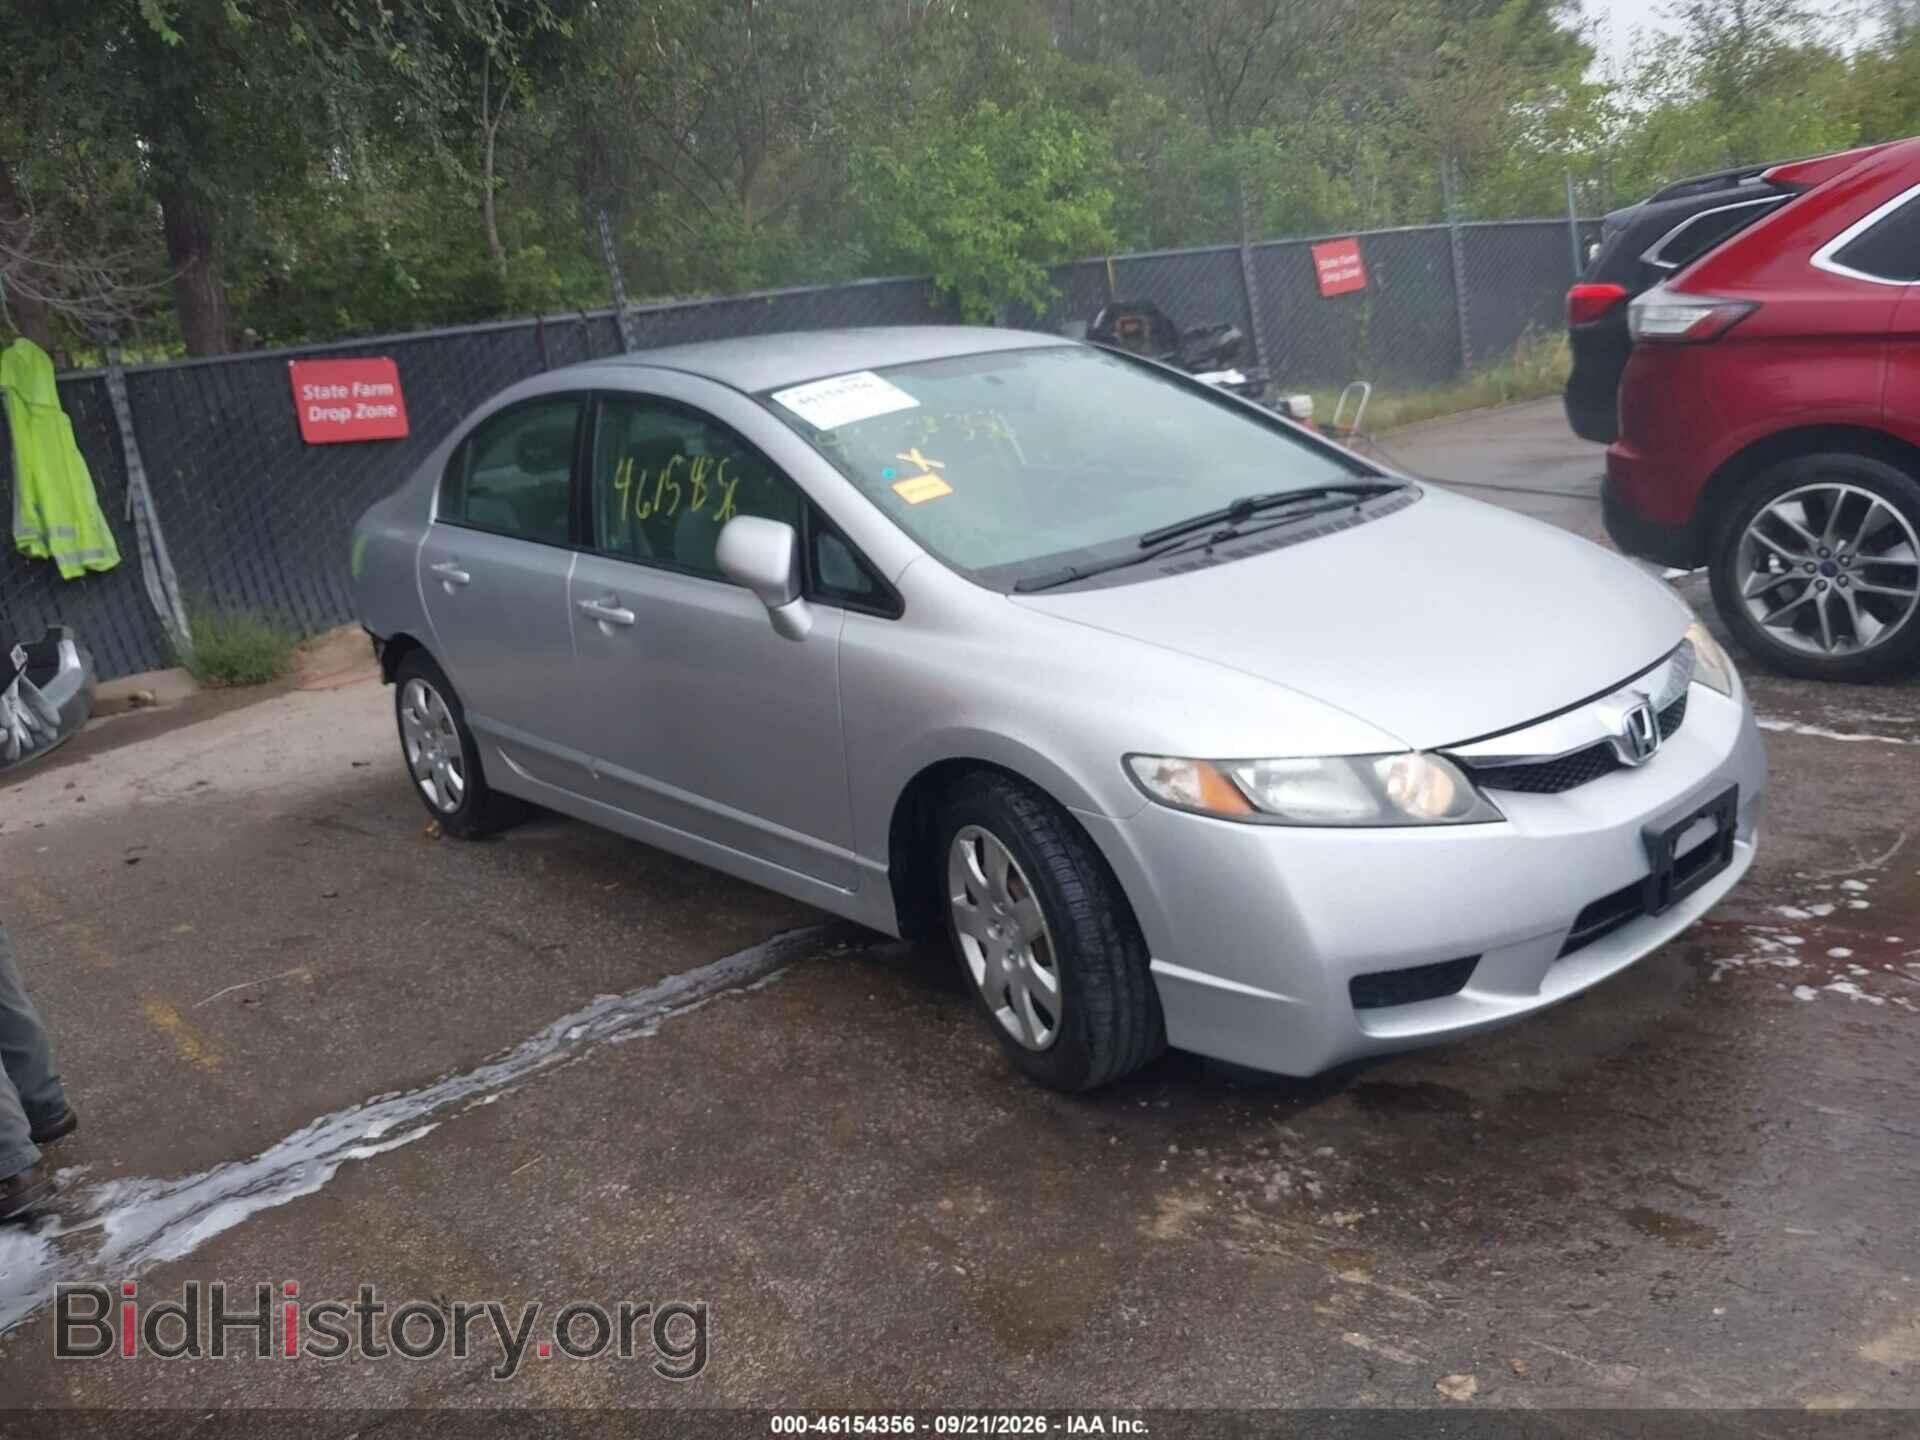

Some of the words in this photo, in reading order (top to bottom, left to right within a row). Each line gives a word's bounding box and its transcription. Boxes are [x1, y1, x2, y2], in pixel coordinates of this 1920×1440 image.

[303, 384, 349, 400] State
[352, 381, 394, 398] Farm
[308, 405, 352, 424] Drop
[355, 402, 397, 419] Zone
